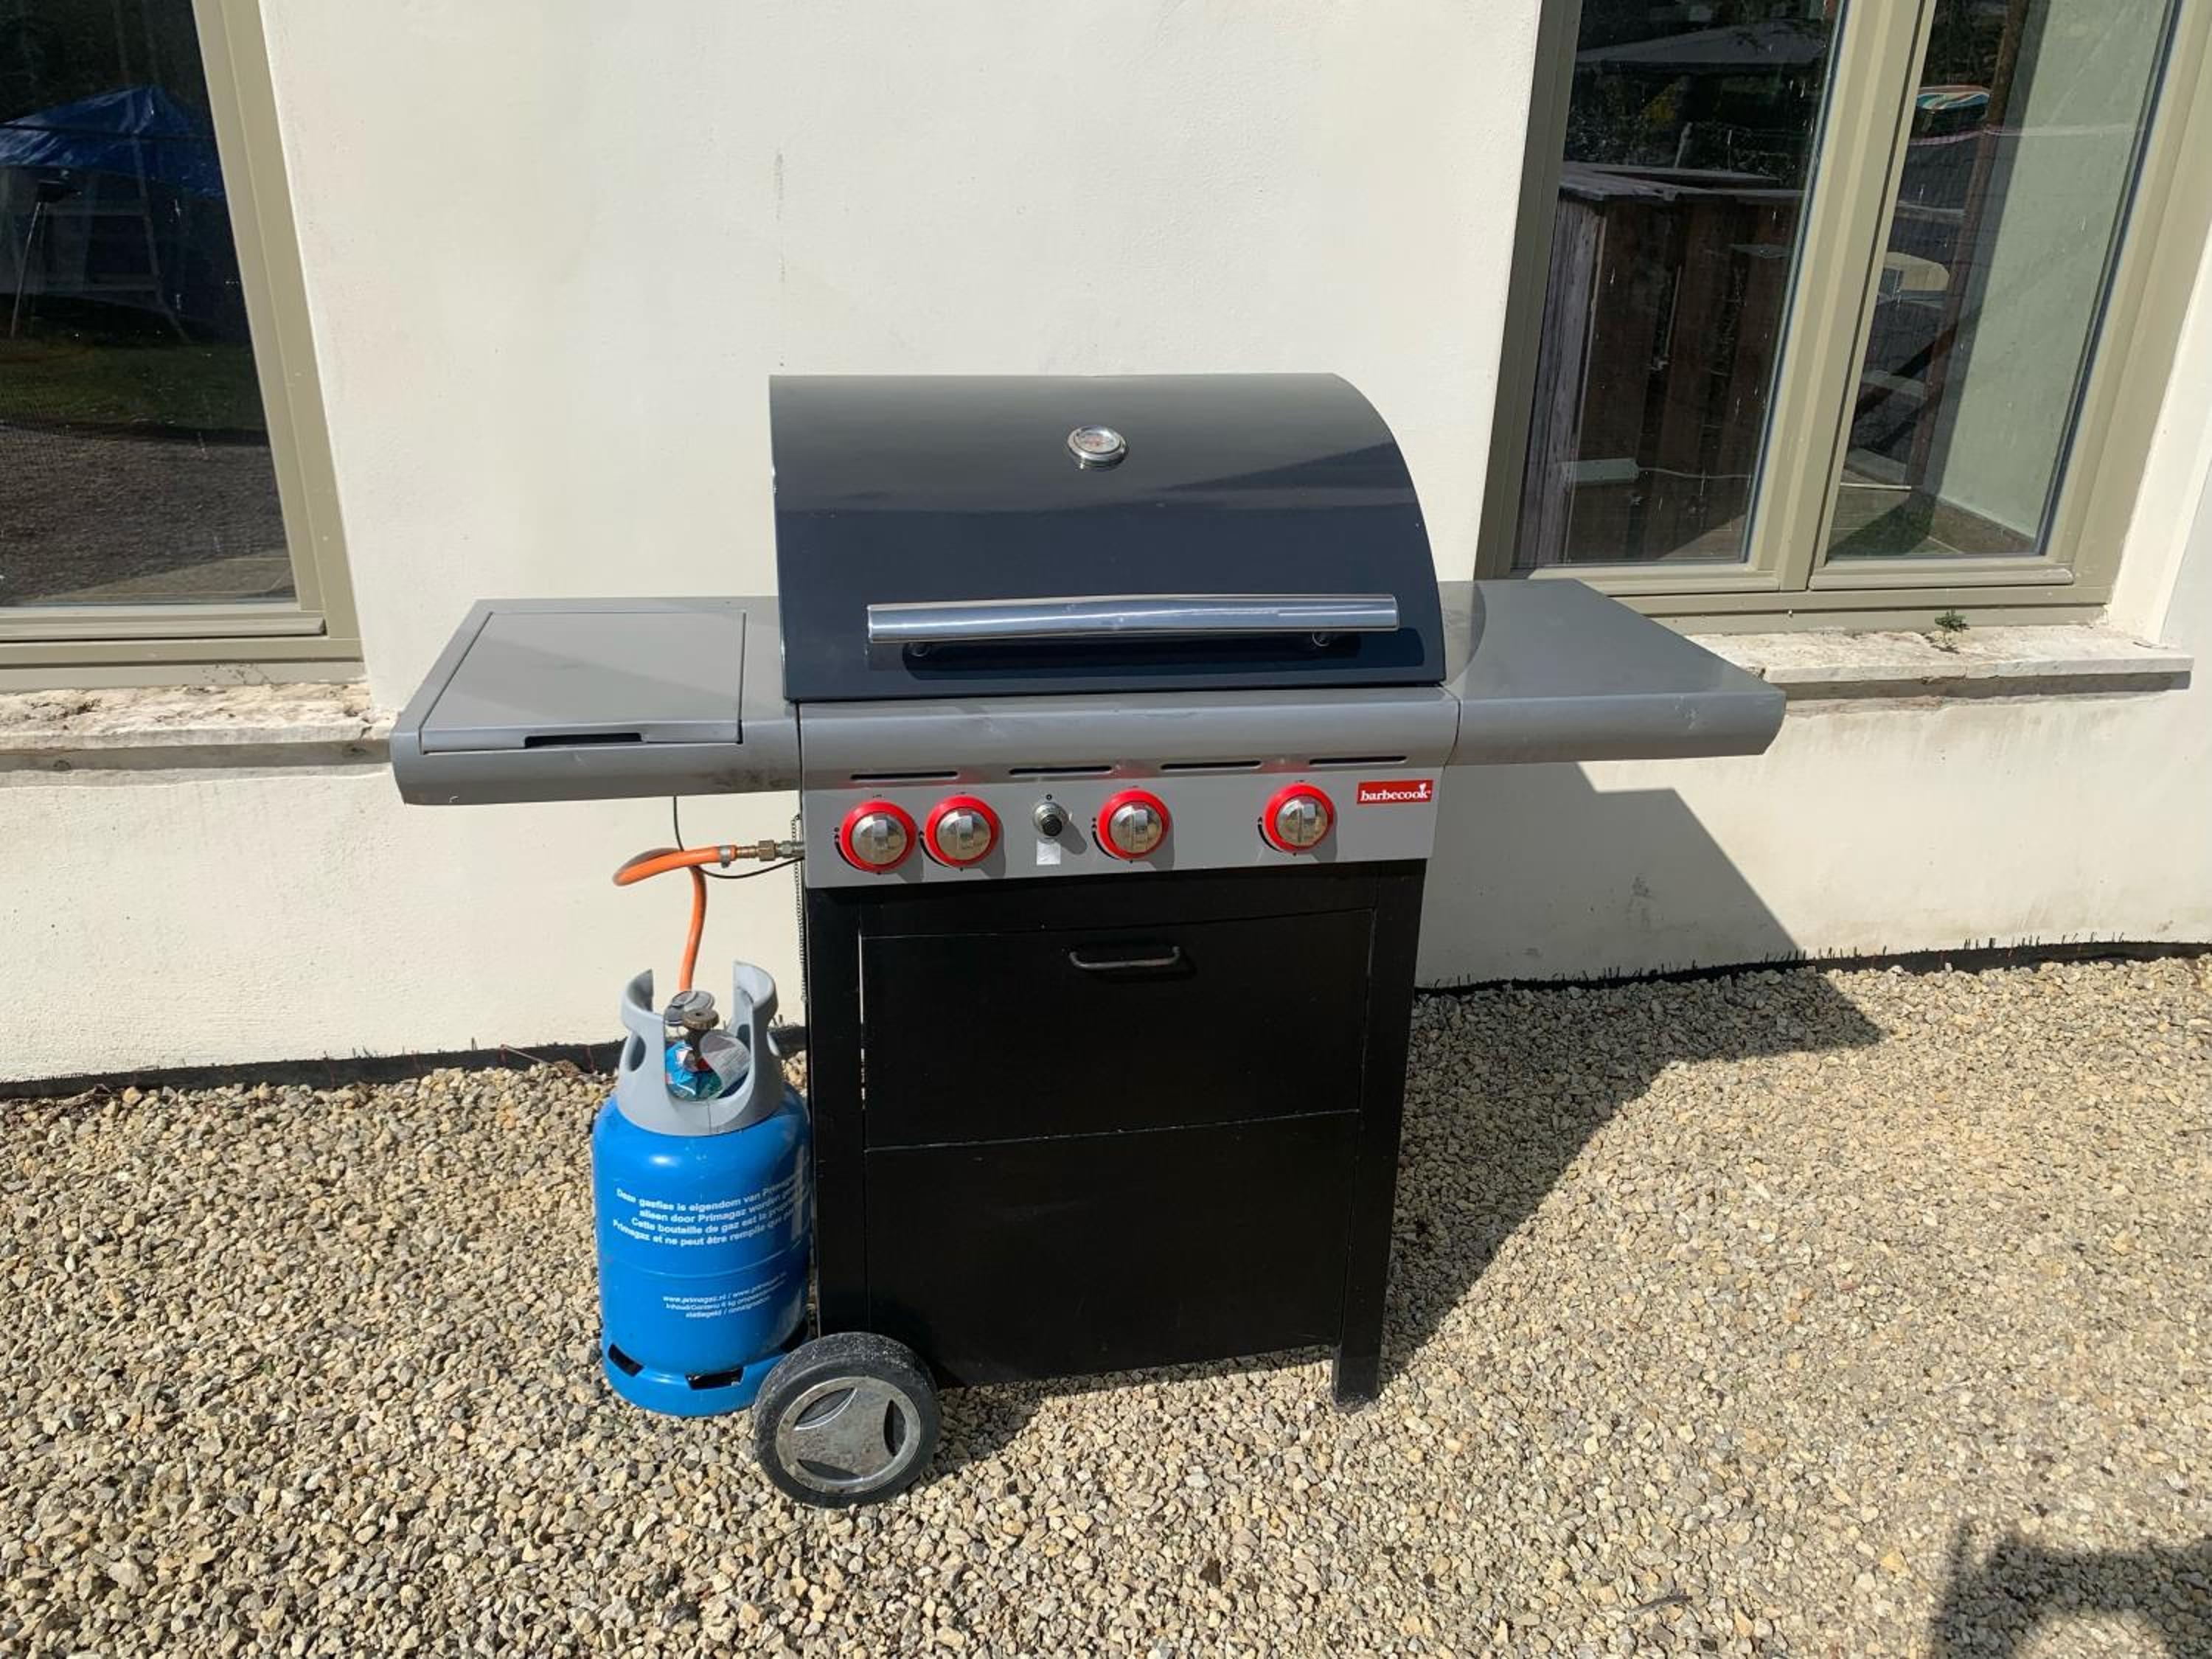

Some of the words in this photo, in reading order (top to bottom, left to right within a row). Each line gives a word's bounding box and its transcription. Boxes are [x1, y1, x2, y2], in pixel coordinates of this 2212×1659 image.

[1360, 783, 1429, 801] barbecook
[616, 1187, 636, 1203] Deze
[639, 1199, 674, 1211] gasfles
[677, 1203, 686, 1211] is
[689, 1199, 741, 1212] eigendom
[743, 1192, 760, 1203] van
[631, 1217, 655, 1231] Cette
[658, 1223, 703, 1234] bouteille
[705, 1225, 718, 1234] de
[721, 1222, 740, 1234] gaz
[742, 1215, 757, 1226] est
[639, 1209, 668, 1221] alleen
[670, 1213, 695, 1222] door
[698, 1209, 746, 1222] Primagaz
[613, 1219, 650, 1240] Primagaz
[653, 1234, 662, 1242] et
[681, 1237, 704, 1247] peut
[706, 1235, 727, 1244] être
[729, 1225, 765, 1241] remplie
